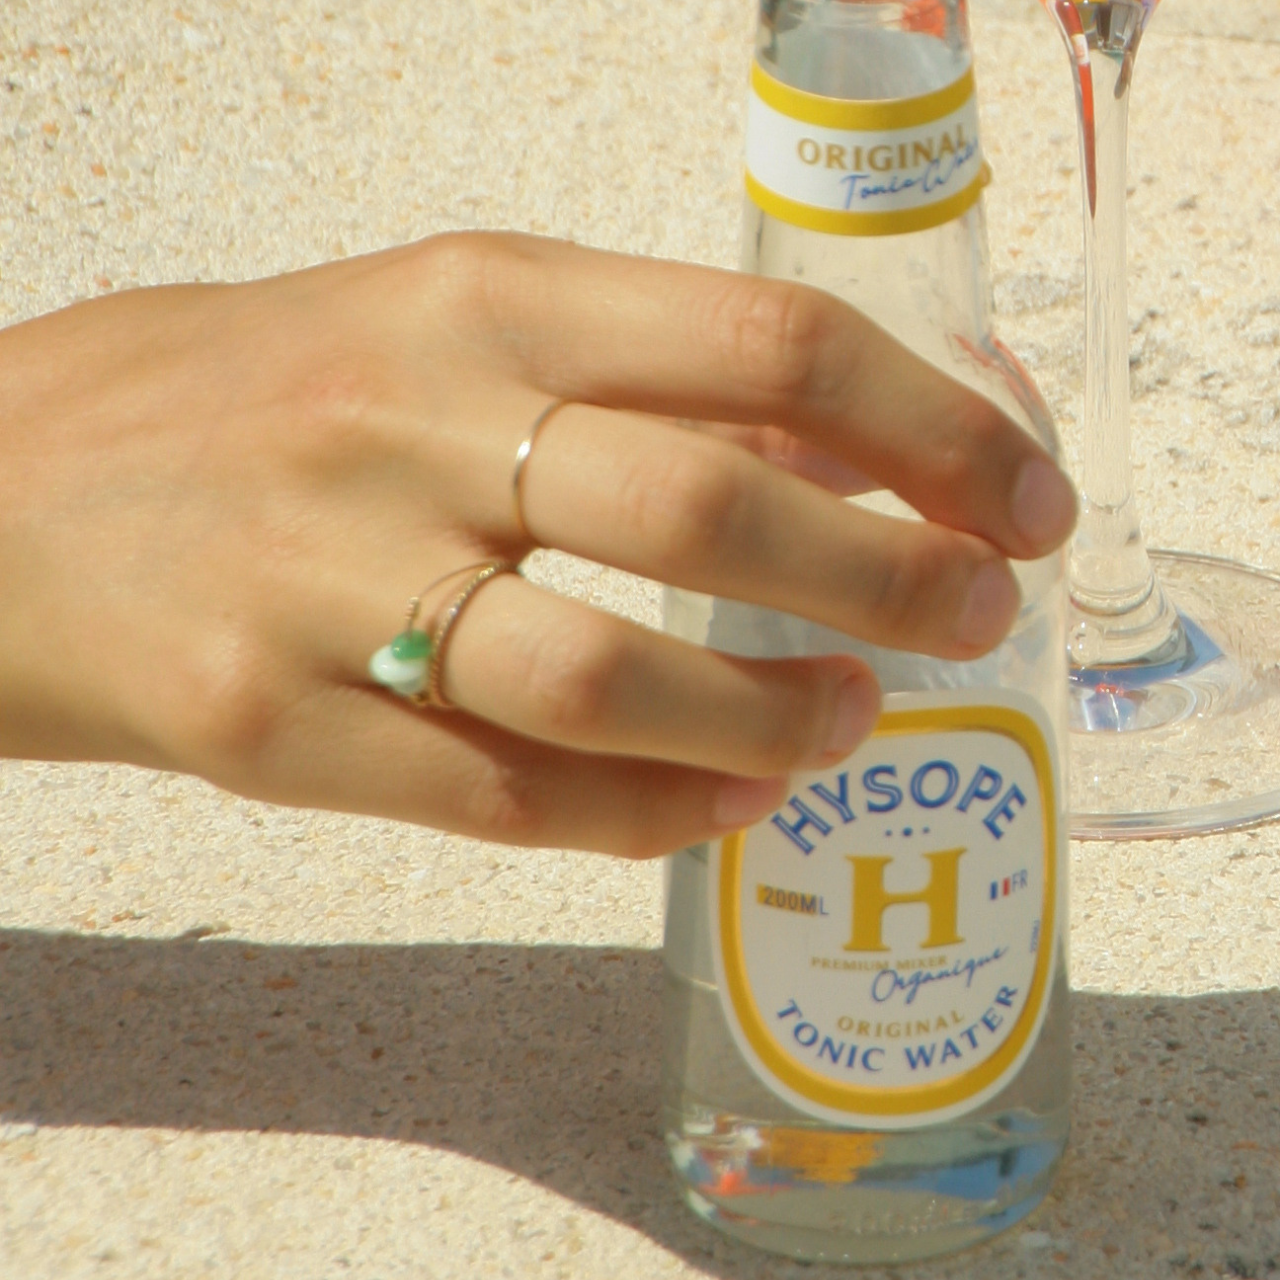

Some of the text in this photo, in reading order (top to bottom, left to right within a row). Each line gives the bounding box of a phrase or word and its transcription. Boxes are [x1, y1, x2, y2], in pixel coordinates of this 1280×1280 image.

[771, 759, 1028, 857] HYSOPE
[762, 883, 830, 917] 200ML
[842, 846, 969, 953] H
[811, 954, 949, 971] PREMIUM MIXER
[871, 945, 1010, 1006] Organique
[777, 984, 1019, 1073] TONIC WATER
[837, 1009, 966, 1039] ORIGINAL
